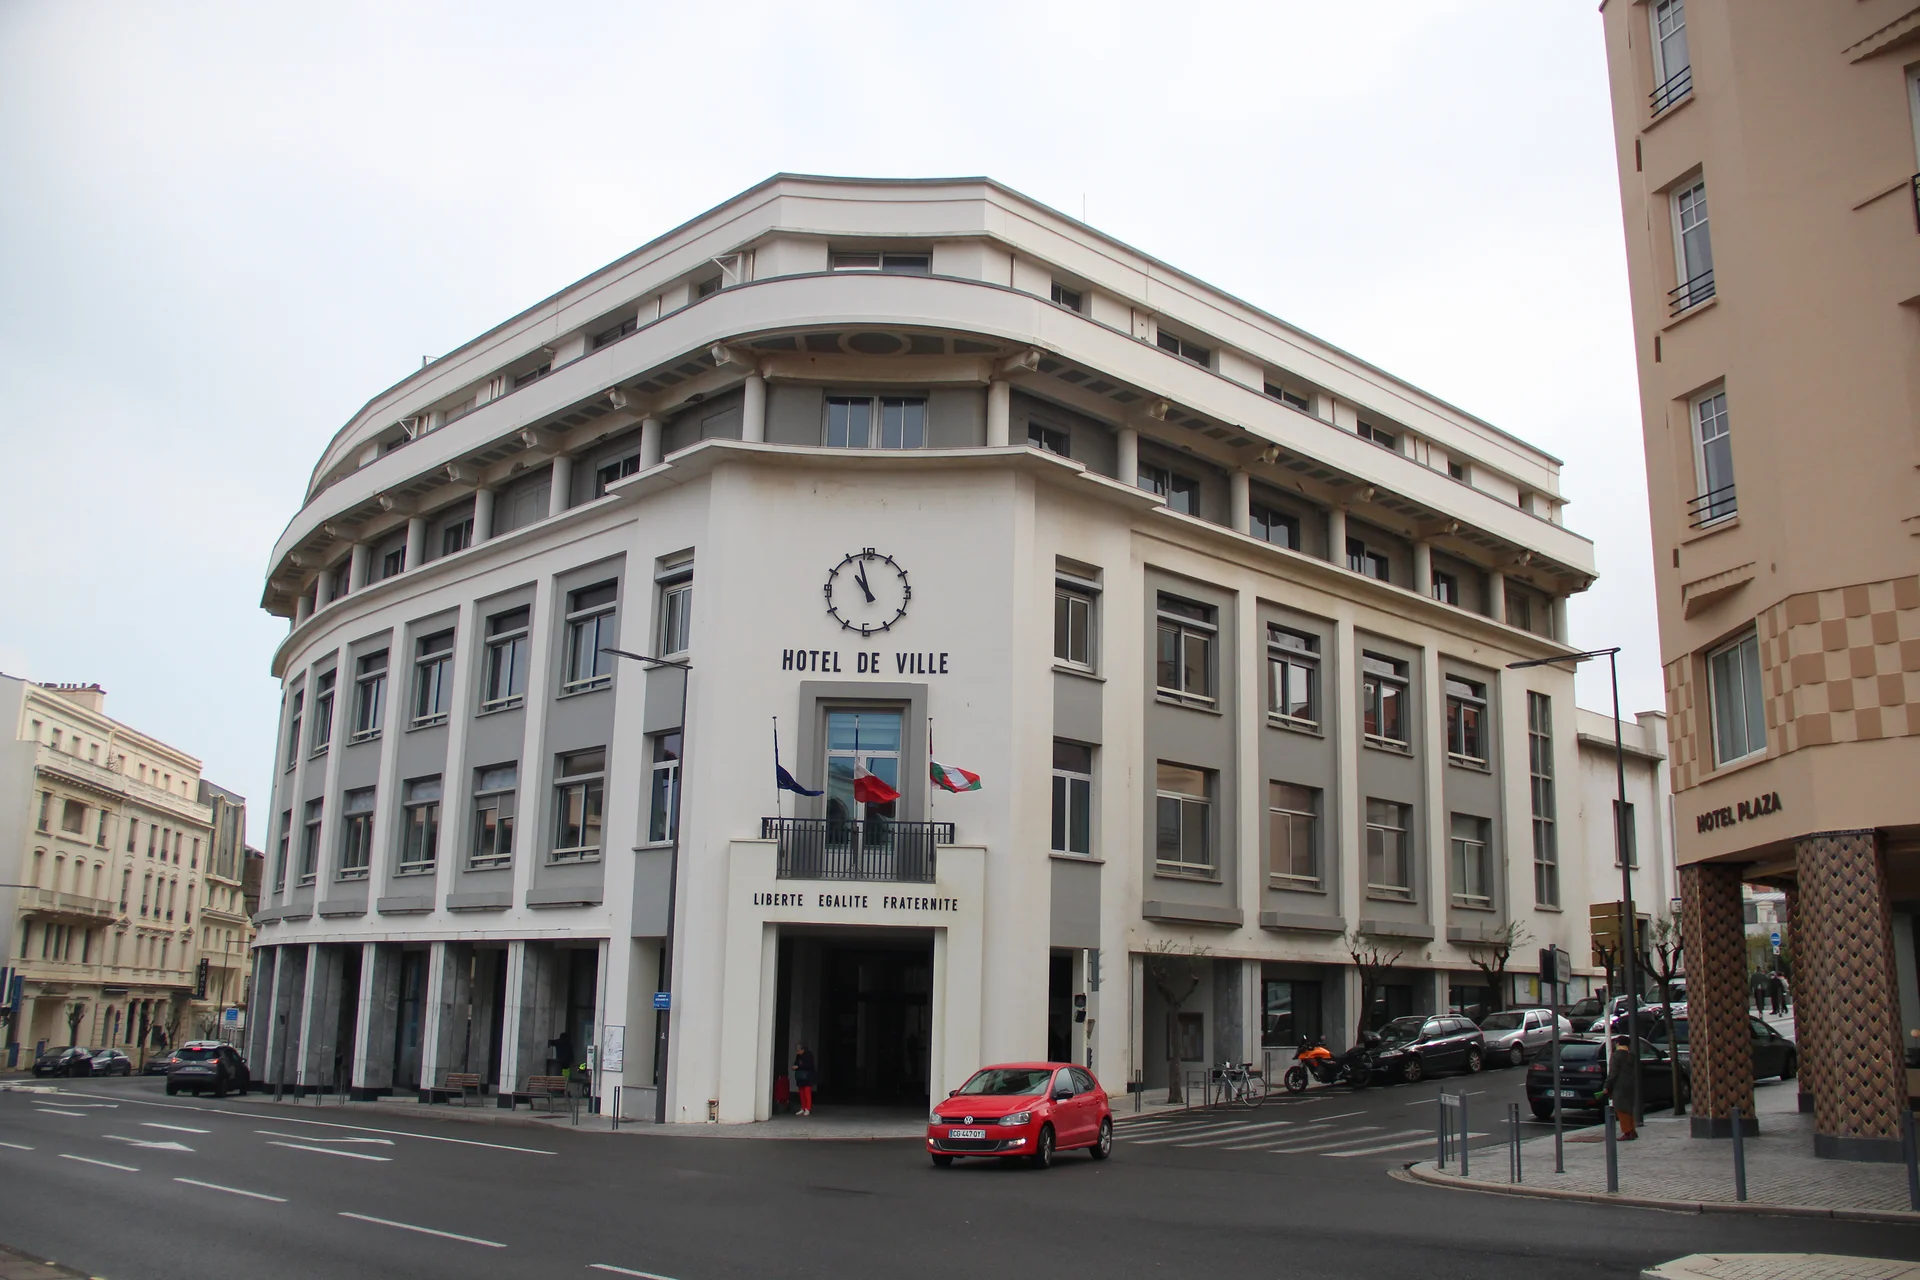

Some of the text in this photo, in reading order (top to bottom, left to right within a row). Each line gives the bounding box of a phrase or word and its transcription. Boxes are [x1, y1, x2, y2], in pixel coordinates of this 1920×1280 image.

[862, 547, 876, 561] 12
[823, 583, 833, 598] 9
[902, 585, 912, 600] 3
[861, 622, 871, 638] 6
[782, 649, 949, 674] HOTEL DE VILLE
[1696, 791, 1783, 834] HOTEL PLAZA
[753, 892, 959, 911] LIBERTE EGALITE FRATERNITE
